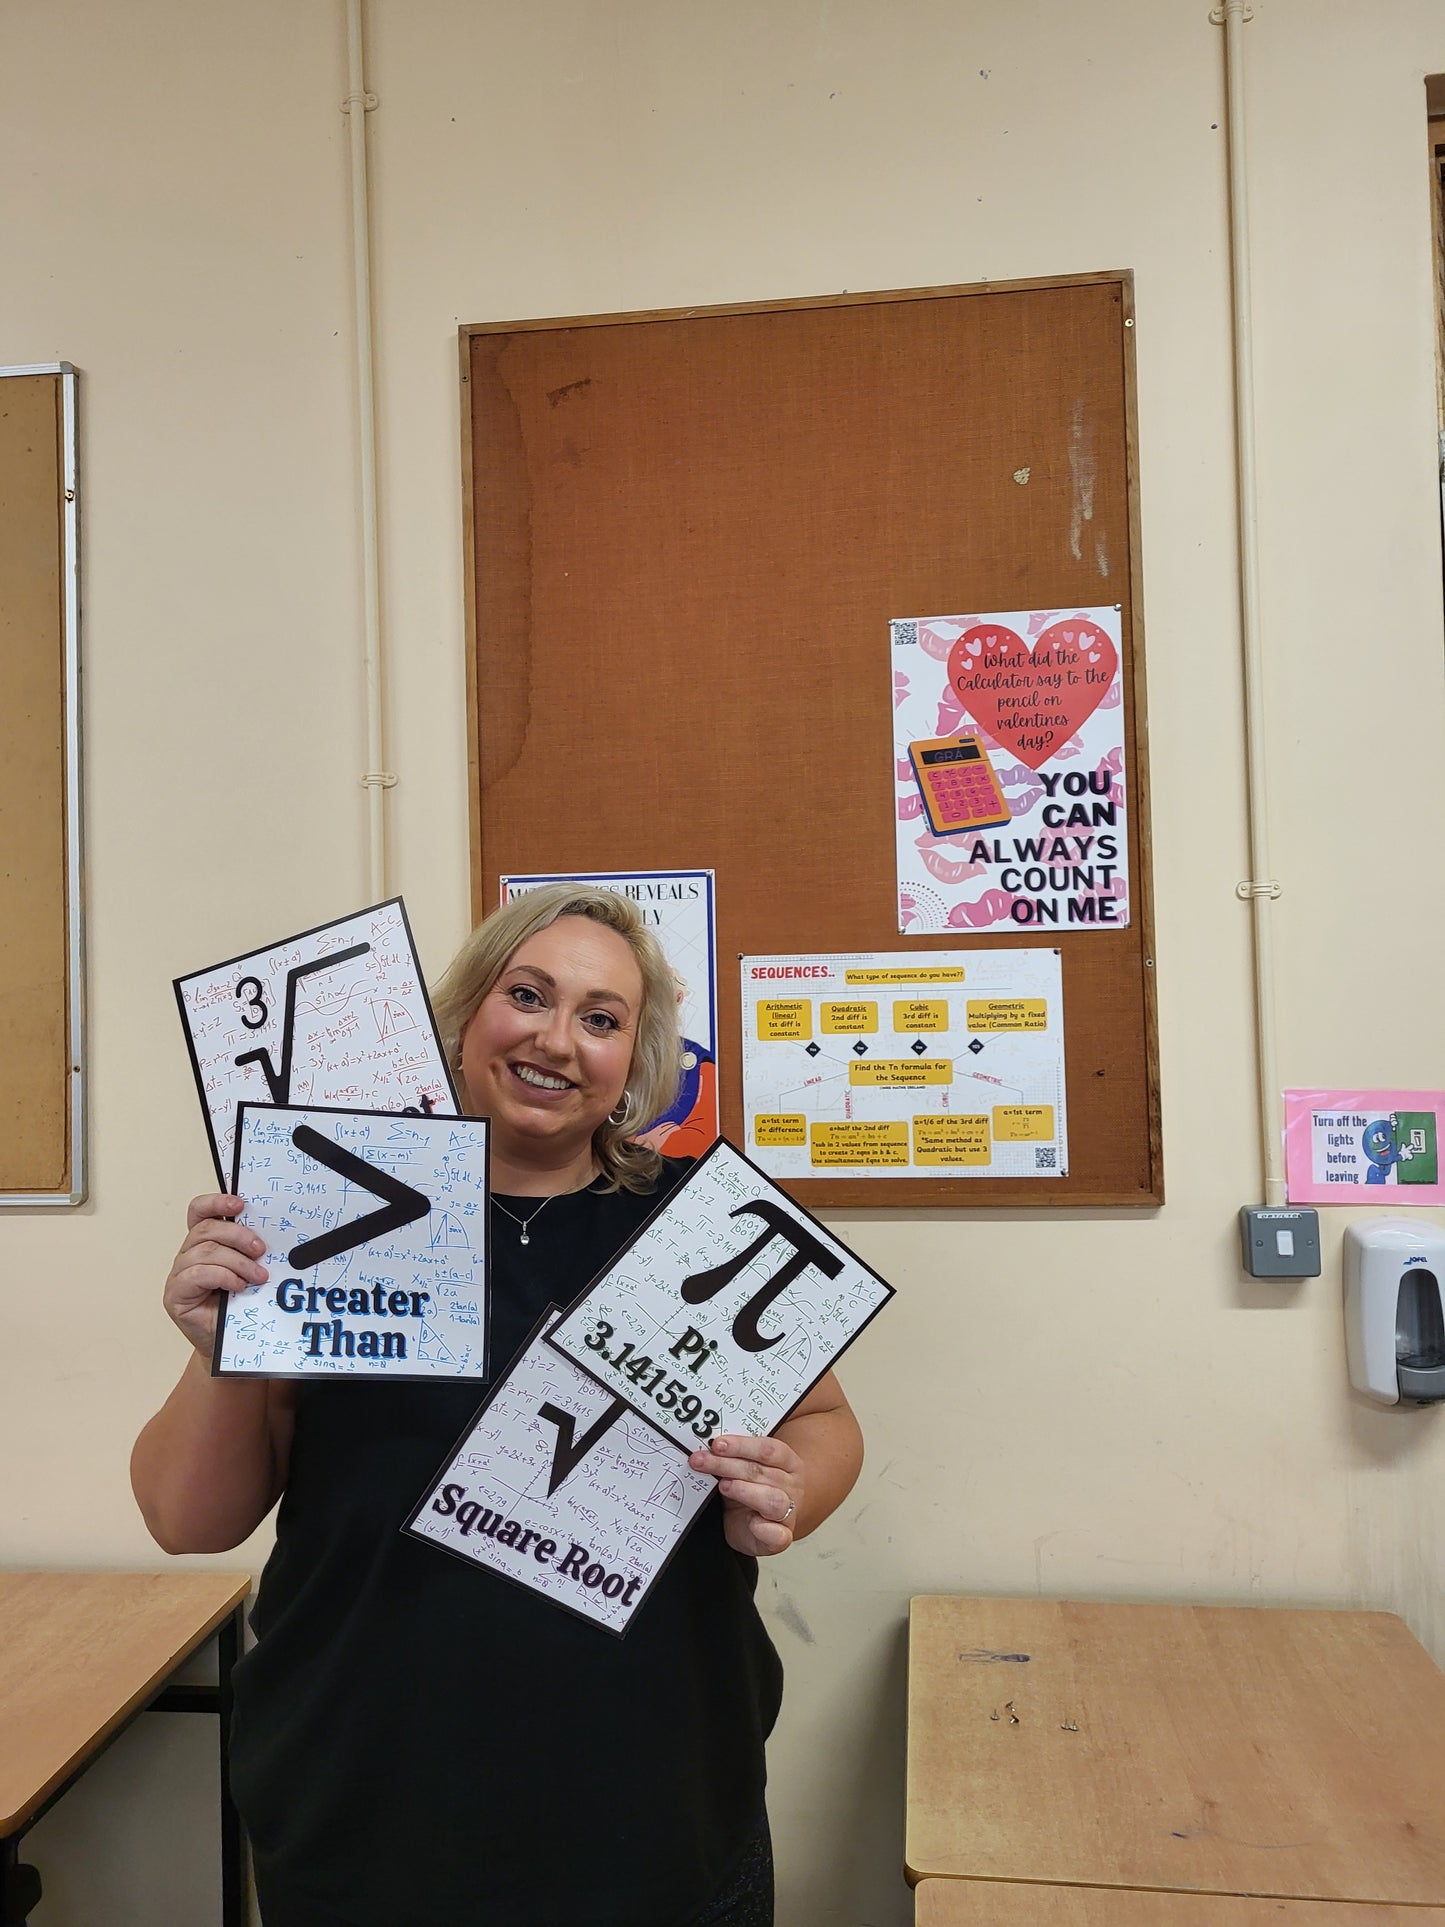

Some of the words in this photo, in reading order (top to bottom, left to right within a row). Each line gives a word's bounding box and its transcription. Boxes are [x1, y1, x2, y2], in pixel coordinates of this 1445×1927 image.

[984, 651, 1024, 670] What
[1028, 651, 1053, 668] did
[1056, 649, 1080, 666] the
[957, 672, 1034, 691] Calculator
[1037, 674, 1063, 690] say
[1066, 670, 1082, 685] to
[1085, 668, 1110, 684] the
[997, 691, 1040, 712] pencil
[1044, 695, 1063, 706] on
[997, 711, 1069, 730] valentines
[1017, 730, 1054, 751] day?
[1038, 771, 1111, 798] YOU
[1042, 801, 1116, 829] CAN
[969, 835, 1118, 865] ALWAYS
[1000, 864, 1117, 893] COUNT
[625, 882, 699, 901] REVEALS
[1011, 898, 1059, 924] ON
[1066, 896, 1118, 922] ME
[751, 965, 836, 980] SEQUENCES..
[866, 973, 879, 981] type
[890, 973, 918, 981] sequence
[928, 972, 940, 980] you
[236, 976, 268, 1030] 3
[831, 1005, 867, 1013] Quadratic
[909, 1003, 929, 1011] Cubic
[988, 1002, 1025, 1010] Geometric
[968, 1012, 1008, 1020] Multiplying
[1009, 1012, 1018, 1020] by
[768, 1020, 779, 1028] 1st
[780, 1020, 793, 1028] diff
[905, 1021, 937, 1029] constant
[988, 1021, 1022, 1029] (Common
[1024, 1020, 1047, 1028] Ratio)
[888, 1063, 899, 1071] Tn
[901, 1063, 932, 1071] formula
[890, 1074, 926, 1082] Sequence
[973, 1117, 989, 1125] diff
[1312, 1114, 1334, 1128] Turn
[1336, 1114, 1350, 1127] off
[1352, 1114, 1367, 1128] the
[1327, 1133, 1354, 1147] lights
[916, 1146, 952, 1154] Quadratic
[940, 1155, 965, 1163] values.
[1326, 1151, 1357, 1165] before
[1325, 1170, 1359, 1185] leaving
[276, 1277, 431, 1319] Greater
[301, 1318, 408, 1360] Than
[668, 1325, 718, 1375] Pi
[432, 1483, 557, 1564] Square
[556, 1542, 641, 1608] Root
